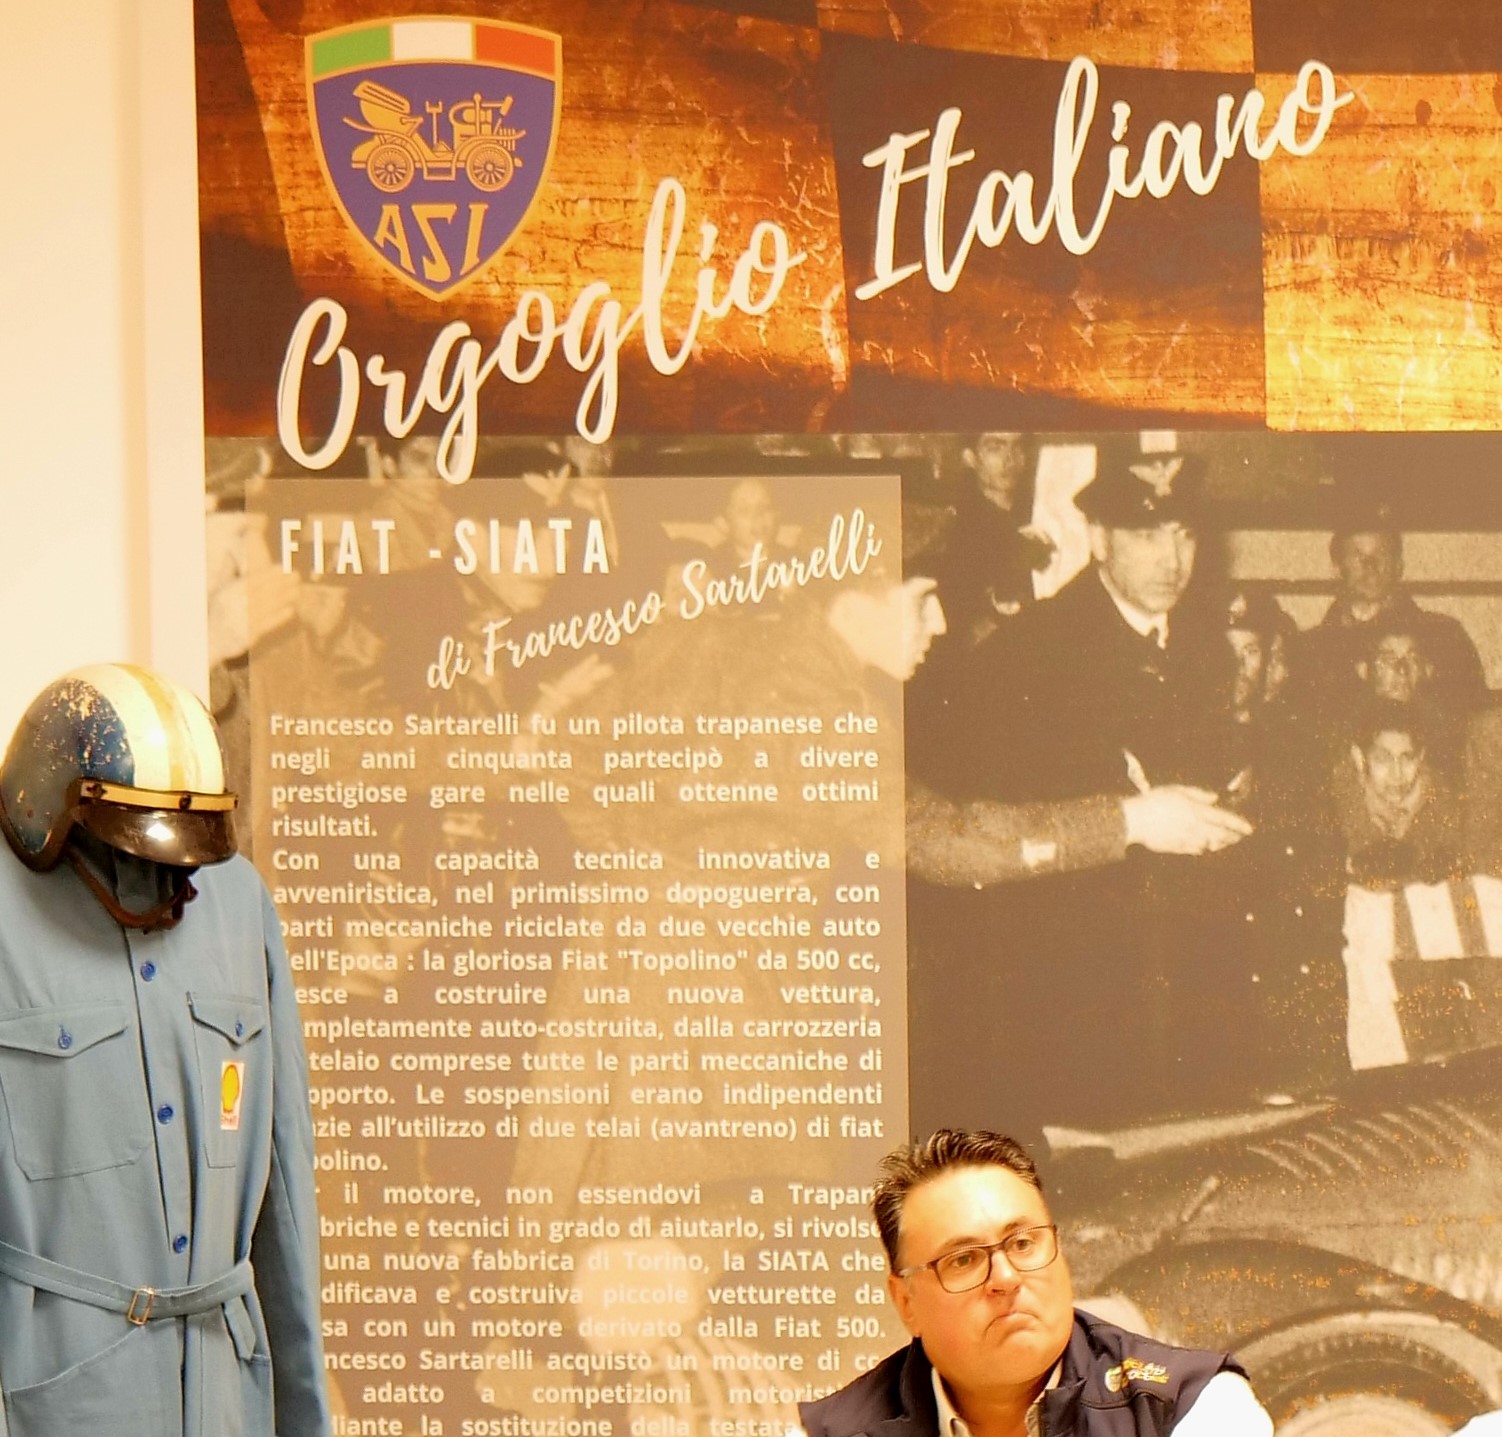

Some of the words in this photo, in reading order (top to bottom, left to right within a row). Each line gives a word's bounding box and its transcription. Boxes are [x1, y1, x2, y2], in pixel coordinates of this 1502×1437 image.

[374, 202, 484, 284] ASI
[276, 176, 807, 486] Orgoglio
[854, 54, 1356, 303] Italiano
[280, 518, 396, 576] FIAT
[426, 636, 471, 691] di
[482, 588, 667, 677] Francesco
[679, 507, 884, 621] Sartarelli
[270, 713, 394, 736] Francesco
[404, 711, 519, 736] Sartarelli
[530, 712, 557, 736] fu
[612, 711, 684, 741] pilota
[694, 713, 822, 741] trapanese
[833, 711, 878, 738] che
[270, 746, 330, 775] negli
[361, 746, 416, 769] anni
[445, 747, 573, 776] cinquanta
[603, 745, 723, 775] partecipò
[799, 744, 878, 768] divere
[271, 780, 407, 809] prestigiose
[429, 785, 485, 809] gare
[508, 780, 569, 803] nelle
[592, 779, 655, 809] quali
[679, 782, 778, 802] ottenne
[802, 778, 879, 802] ottimi
[271, 813, 378, 837] risultati.
[271, 848, 320, 871] Con
[353, 852, 401, 871] una
[434, 847, 539, 877] capacità
[572, 847, 663, 871] tecnica
[698, 844, 831, 870] innovativa
[273, 881, 438, 907] avveniristica,
[454, 880, 494, 904] nel
[510, 880, 650, 910] primissimo
[665, 877, 818, 910] dopoguerra,
[834, 884, 880, 903] con
[345, 913, 493, 938] meccaniche
[503, 914, 604, 938] riciclate
[658, 914, 705, 937] due
[716, 913, 811, 937] vecchie
[822, 916, 881, 937] auto
[453, 947, 552, 977] gloriosa
[561, 948, 609, 971] Fiat
[797, 948, 840, 971] 500
[847, 952, 881, 973] cc,
[434, 981, 547, 1005] costruire
[666, 986, 744, 1004] nuova
[780, 983, 881, 1007] vettura,
[479, 1016, 664, 1041] auto-costruita,
[673, 1014, 734, 1038] dalla
[742, 1014, 882, 1038] carrozzeria
[308, 1048, 380, 1071] telaio
[389, 1053, 511, 1077] comprese
[520, 1050, 585, 1072] tutte
[628, 1048, 689, 1077] parti
[700, 1047, 848, 1071] meccaniche
[415, 1083, 444, 1105] Le
[463, 1081, 610, 1111] sospensioni
[630, 1087, 703, 1105] erano
[723, 1081, 883, 1111] indipendenti
[584, 1115, 641, 1138] telai
[650, 1116, 797, 1142] (avantreno)
[839, 1115, 884, 1138] fiat
[382, 1184, 481, 1208] motore,
[577, 1182, 701, 1205] essendovi
[426, 1215, 510, 1238] tecnici
[548, 1214, 621, 1244] grado
[659, 1215, 766, 1241] aiutarlo,
[382, 1253, 460, 1271] nuova
[471, 1247, 574, 1272] fabbrica
[758, 1249, 830, 1272] SIATA
[840, 1248, 885, 1272] che
[707, 1284, 836, 1305] vetturette
[470, 1317, 562, 1338] motore
[697, 1314, 759, 1338] dalla
[774, 1316, 822, 1338] Fiat
[418, 1348, 533, 1371] Sartarelli
[546, 1350, 653, 1379] acquistò
[708, 1349, 804, 1372] motore
[362, 1380, 445, 1404] adatto
[532, 1381, 690, 1410] competizioni
[461, 1413, 612, 1437] sostituzione
